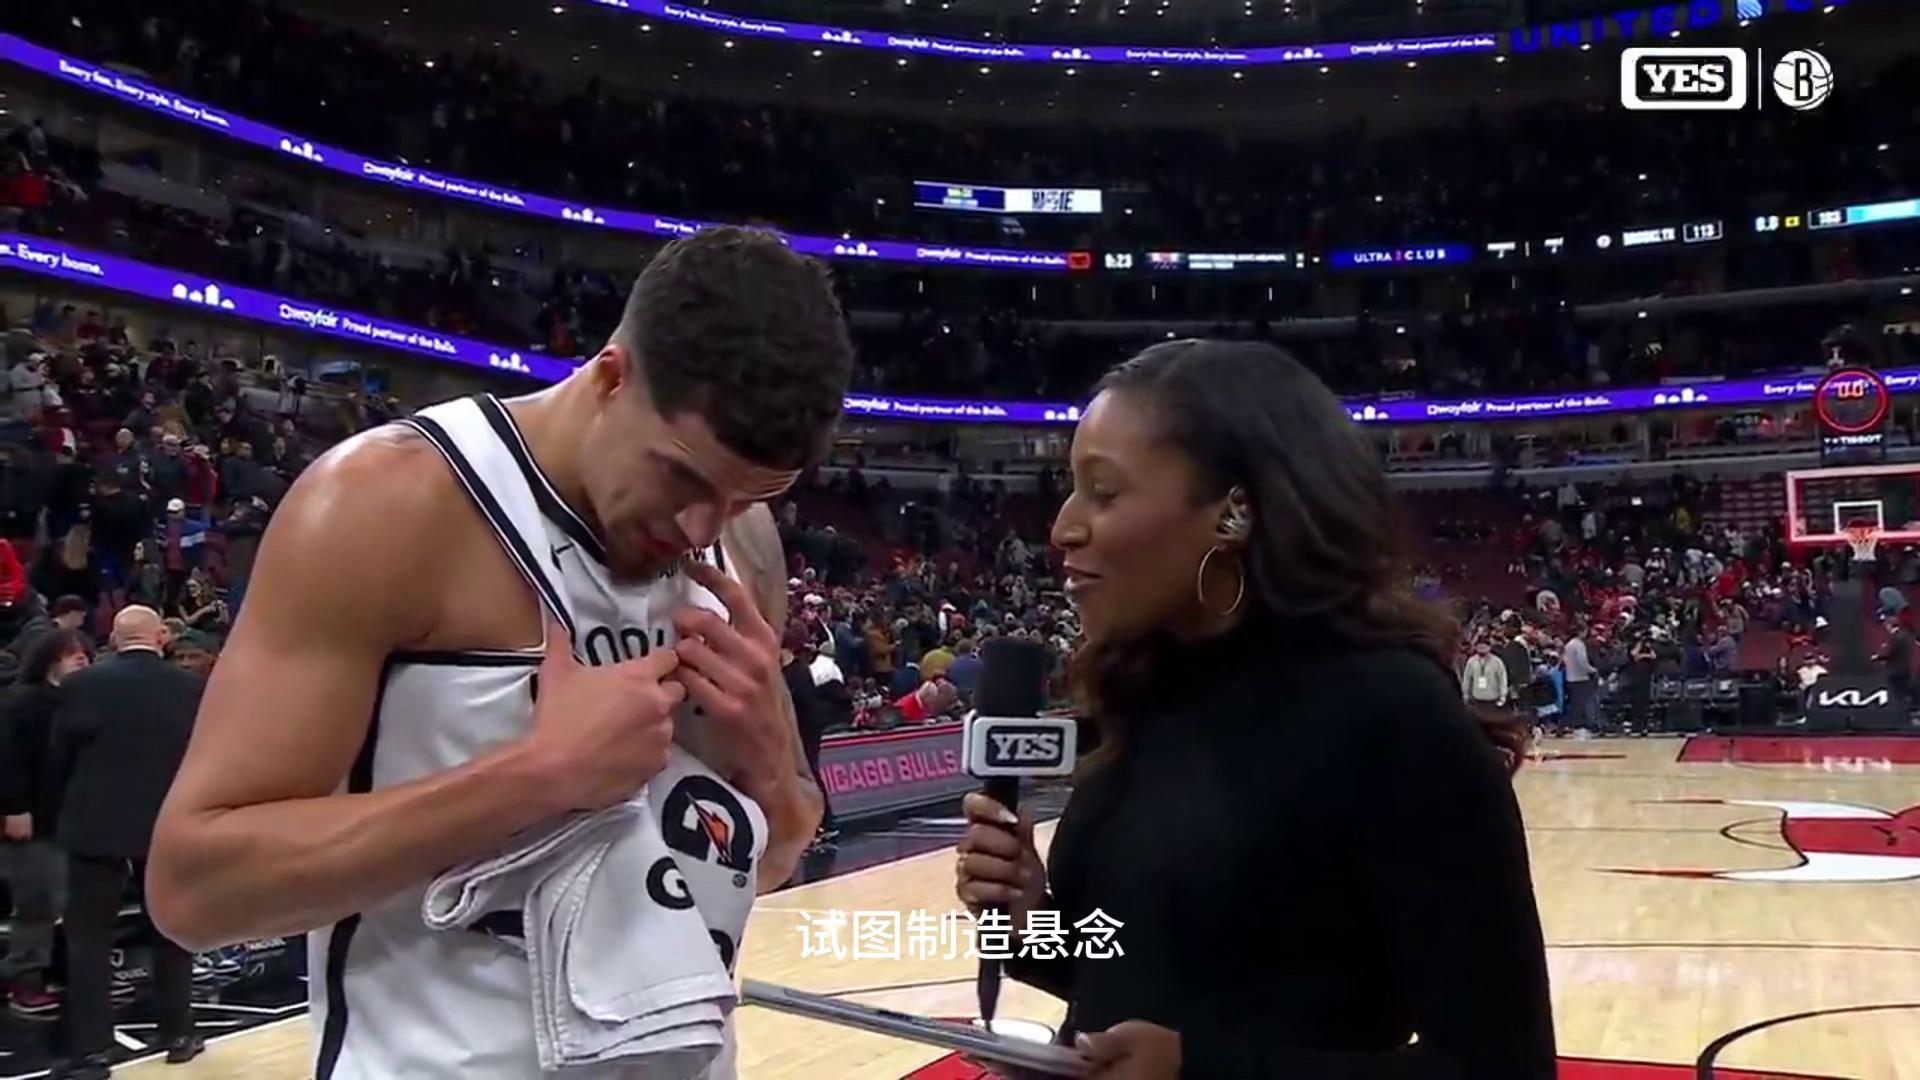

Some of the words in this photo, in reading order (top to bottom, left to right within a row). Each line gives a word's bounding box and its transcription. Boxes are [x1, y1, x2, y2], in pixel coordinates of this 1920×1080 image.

[1511, 1, 1721, 53] UNITED
[17, 243, 60, 269] Every
[61, 252, 104, 275] home.
[1354, 251, 1392, 263] ULTRA
[1404, 248, 1445, 261] CLUB
[1763, 384, 1795, 395] Every
[1436, 401, 1483, 415] wayfair
[1486, 401, 1515, 412] Proud
[1516, 399, 1553, 412] partner
[1554, 398, 1565, 408] of
[1566, 397, 1583, 407] the
[1840, 434, 1882, 444] TISSOT
[991, 733, 1060, 761] YES
[899, 749, 958, 782] BULLS
